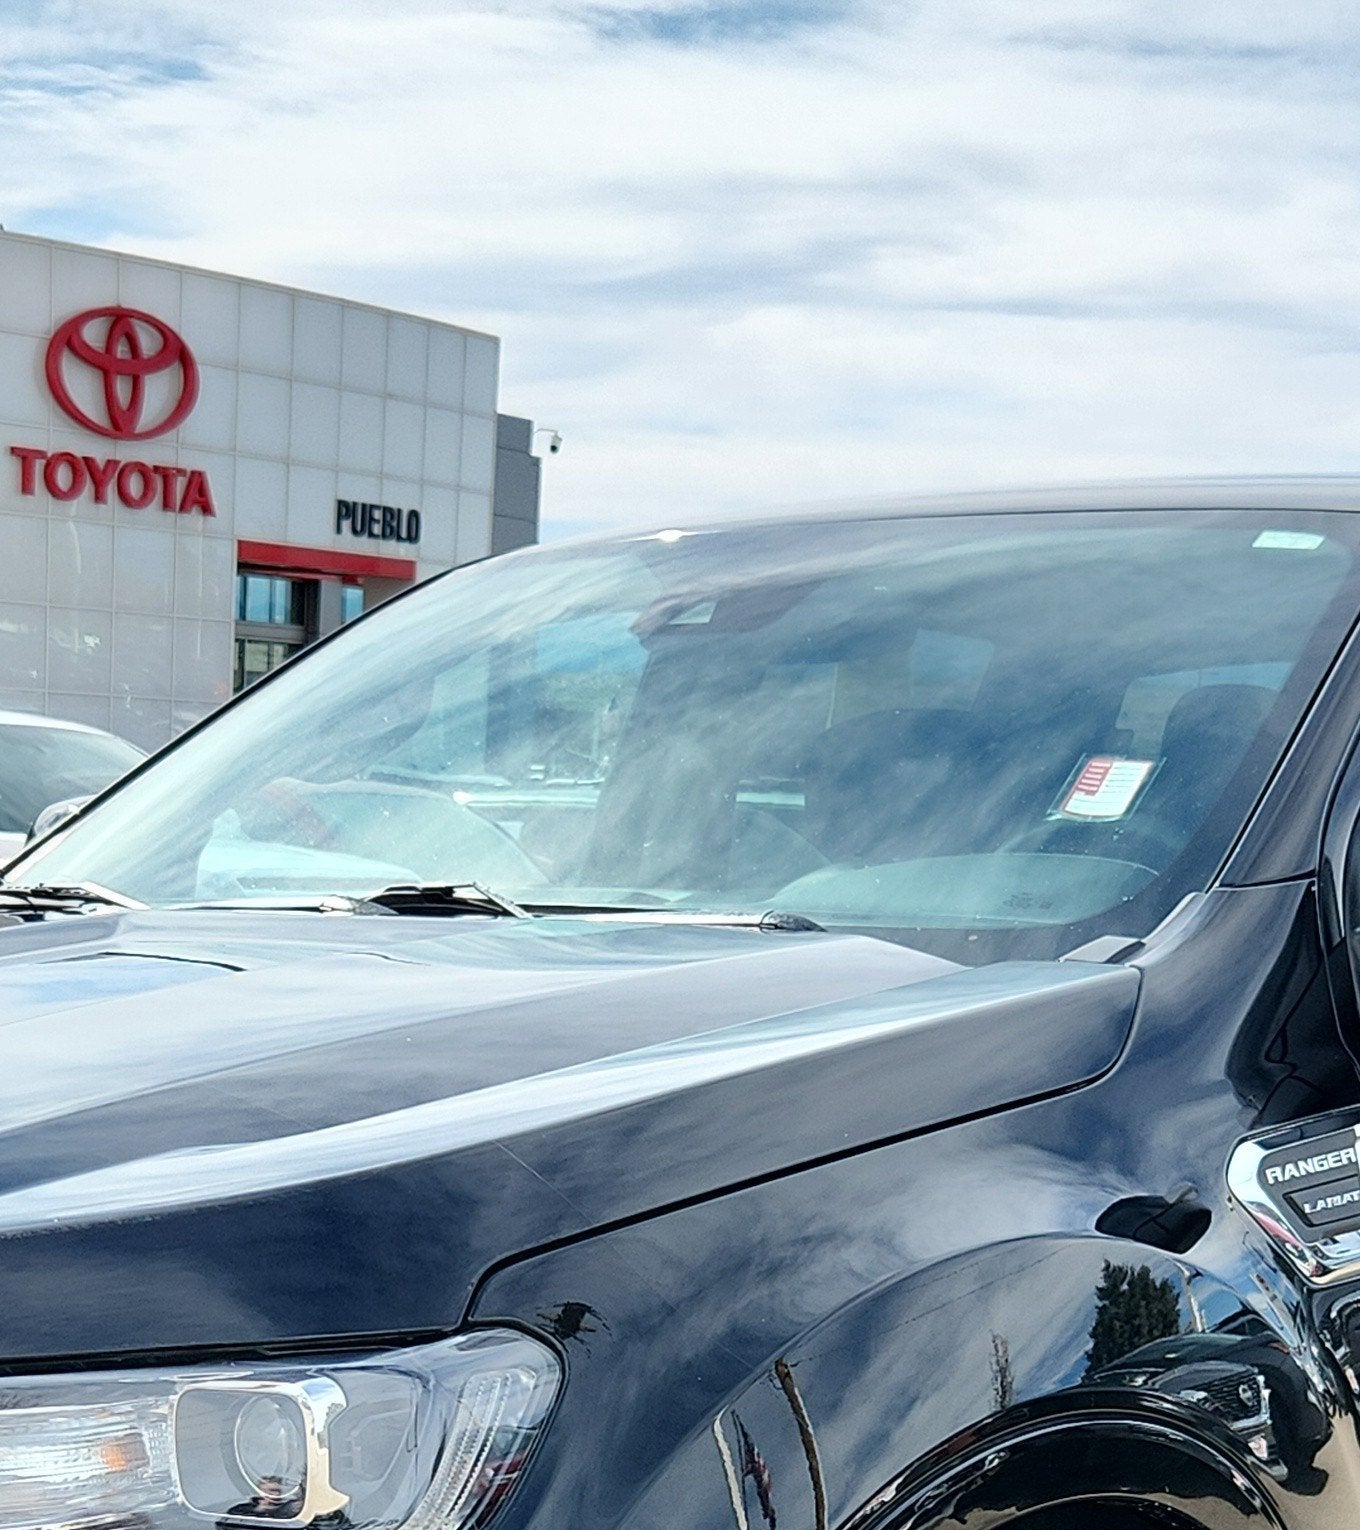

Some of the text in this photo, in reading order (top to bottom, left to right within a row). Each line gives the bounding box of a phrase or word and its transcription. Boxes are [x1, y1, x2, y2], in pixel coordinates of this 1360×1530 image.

[9, 446, 217, 517] TOYOTA
[336, 499, 421, 544] PUEBLO
[1265, 1147, 1357, 1184] RANGER
